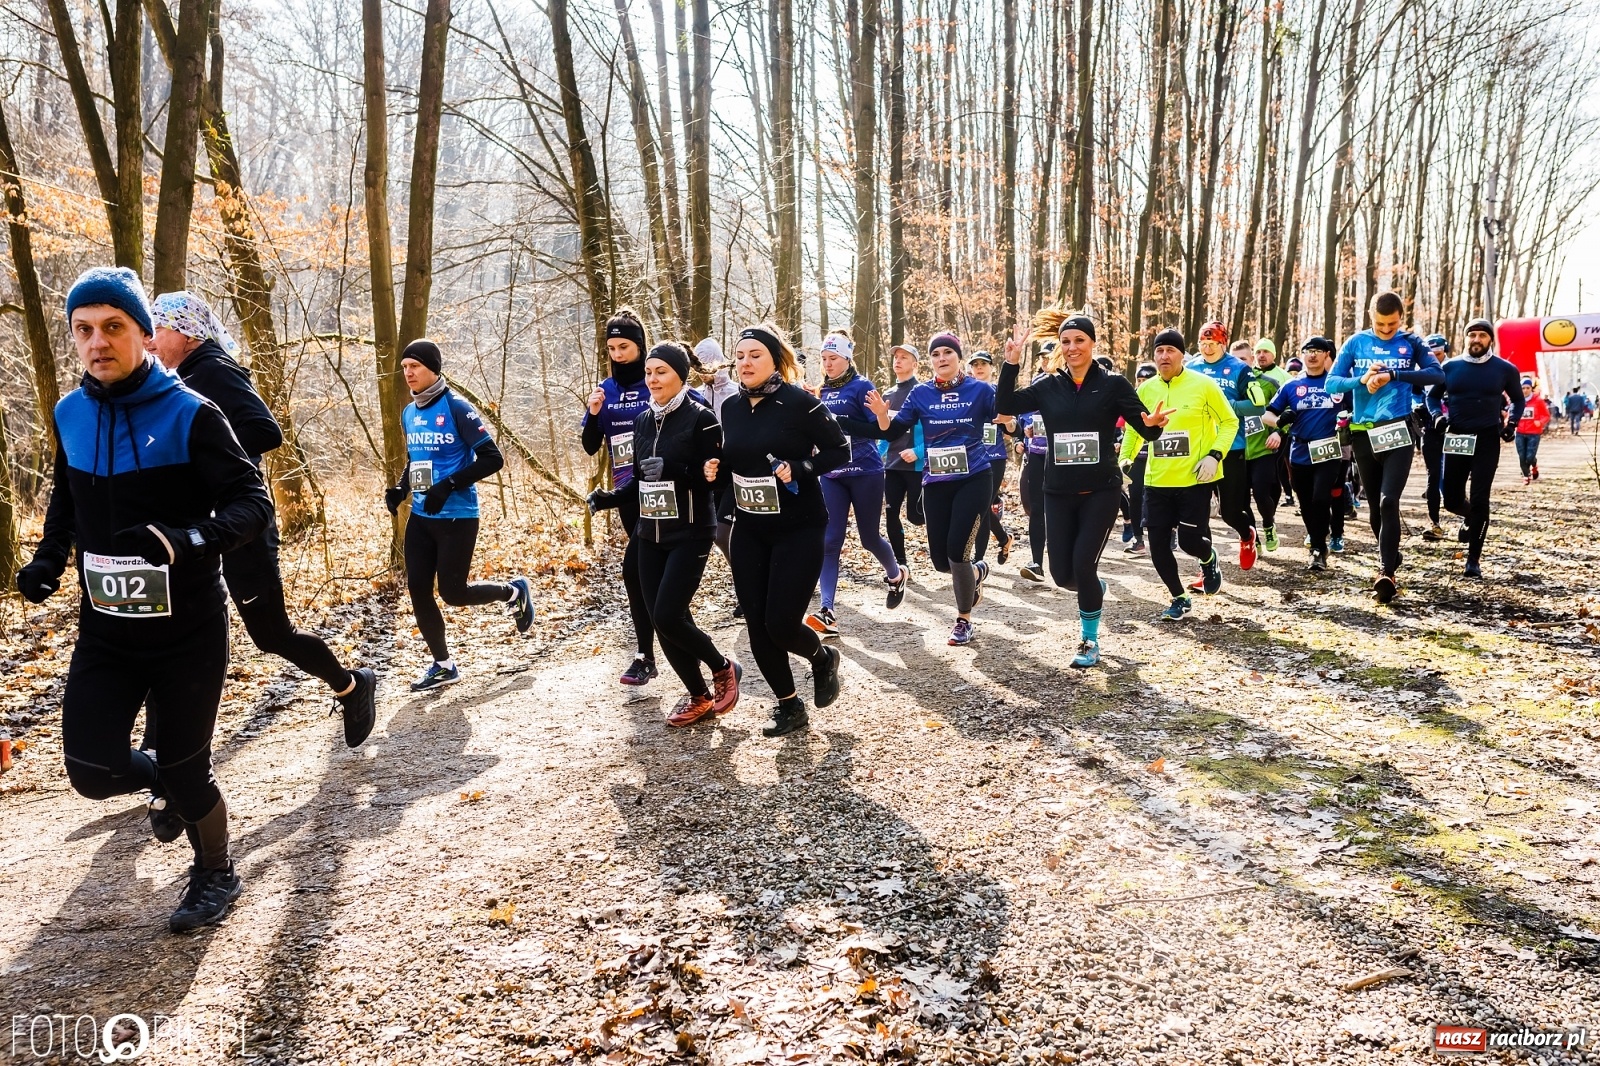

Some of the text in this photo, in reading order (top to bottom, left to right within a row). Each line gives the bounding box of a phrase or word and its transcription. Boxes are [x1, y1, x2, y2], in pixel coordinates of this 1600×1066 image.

[929, 402, 973, 410] FEROCITY
[1377, 430, 1402, 444] 094
[1449, 438, 1469, 448] 034
[618, 443, 634, 457] 04
[1066, 442, 1087, 456] 112
[1160, 440, 1180, 451] 127
[1317, 444, 1335, 456] 016
[936, 455, 958, 468] 100
[643, 493, 667, 508] 054
[740, 487, 765, 504] 013
[96, 557, 111, 565] BIEG
[111, 558, 152, 566] Twardzie
[101, 574, 147, 599] 012
